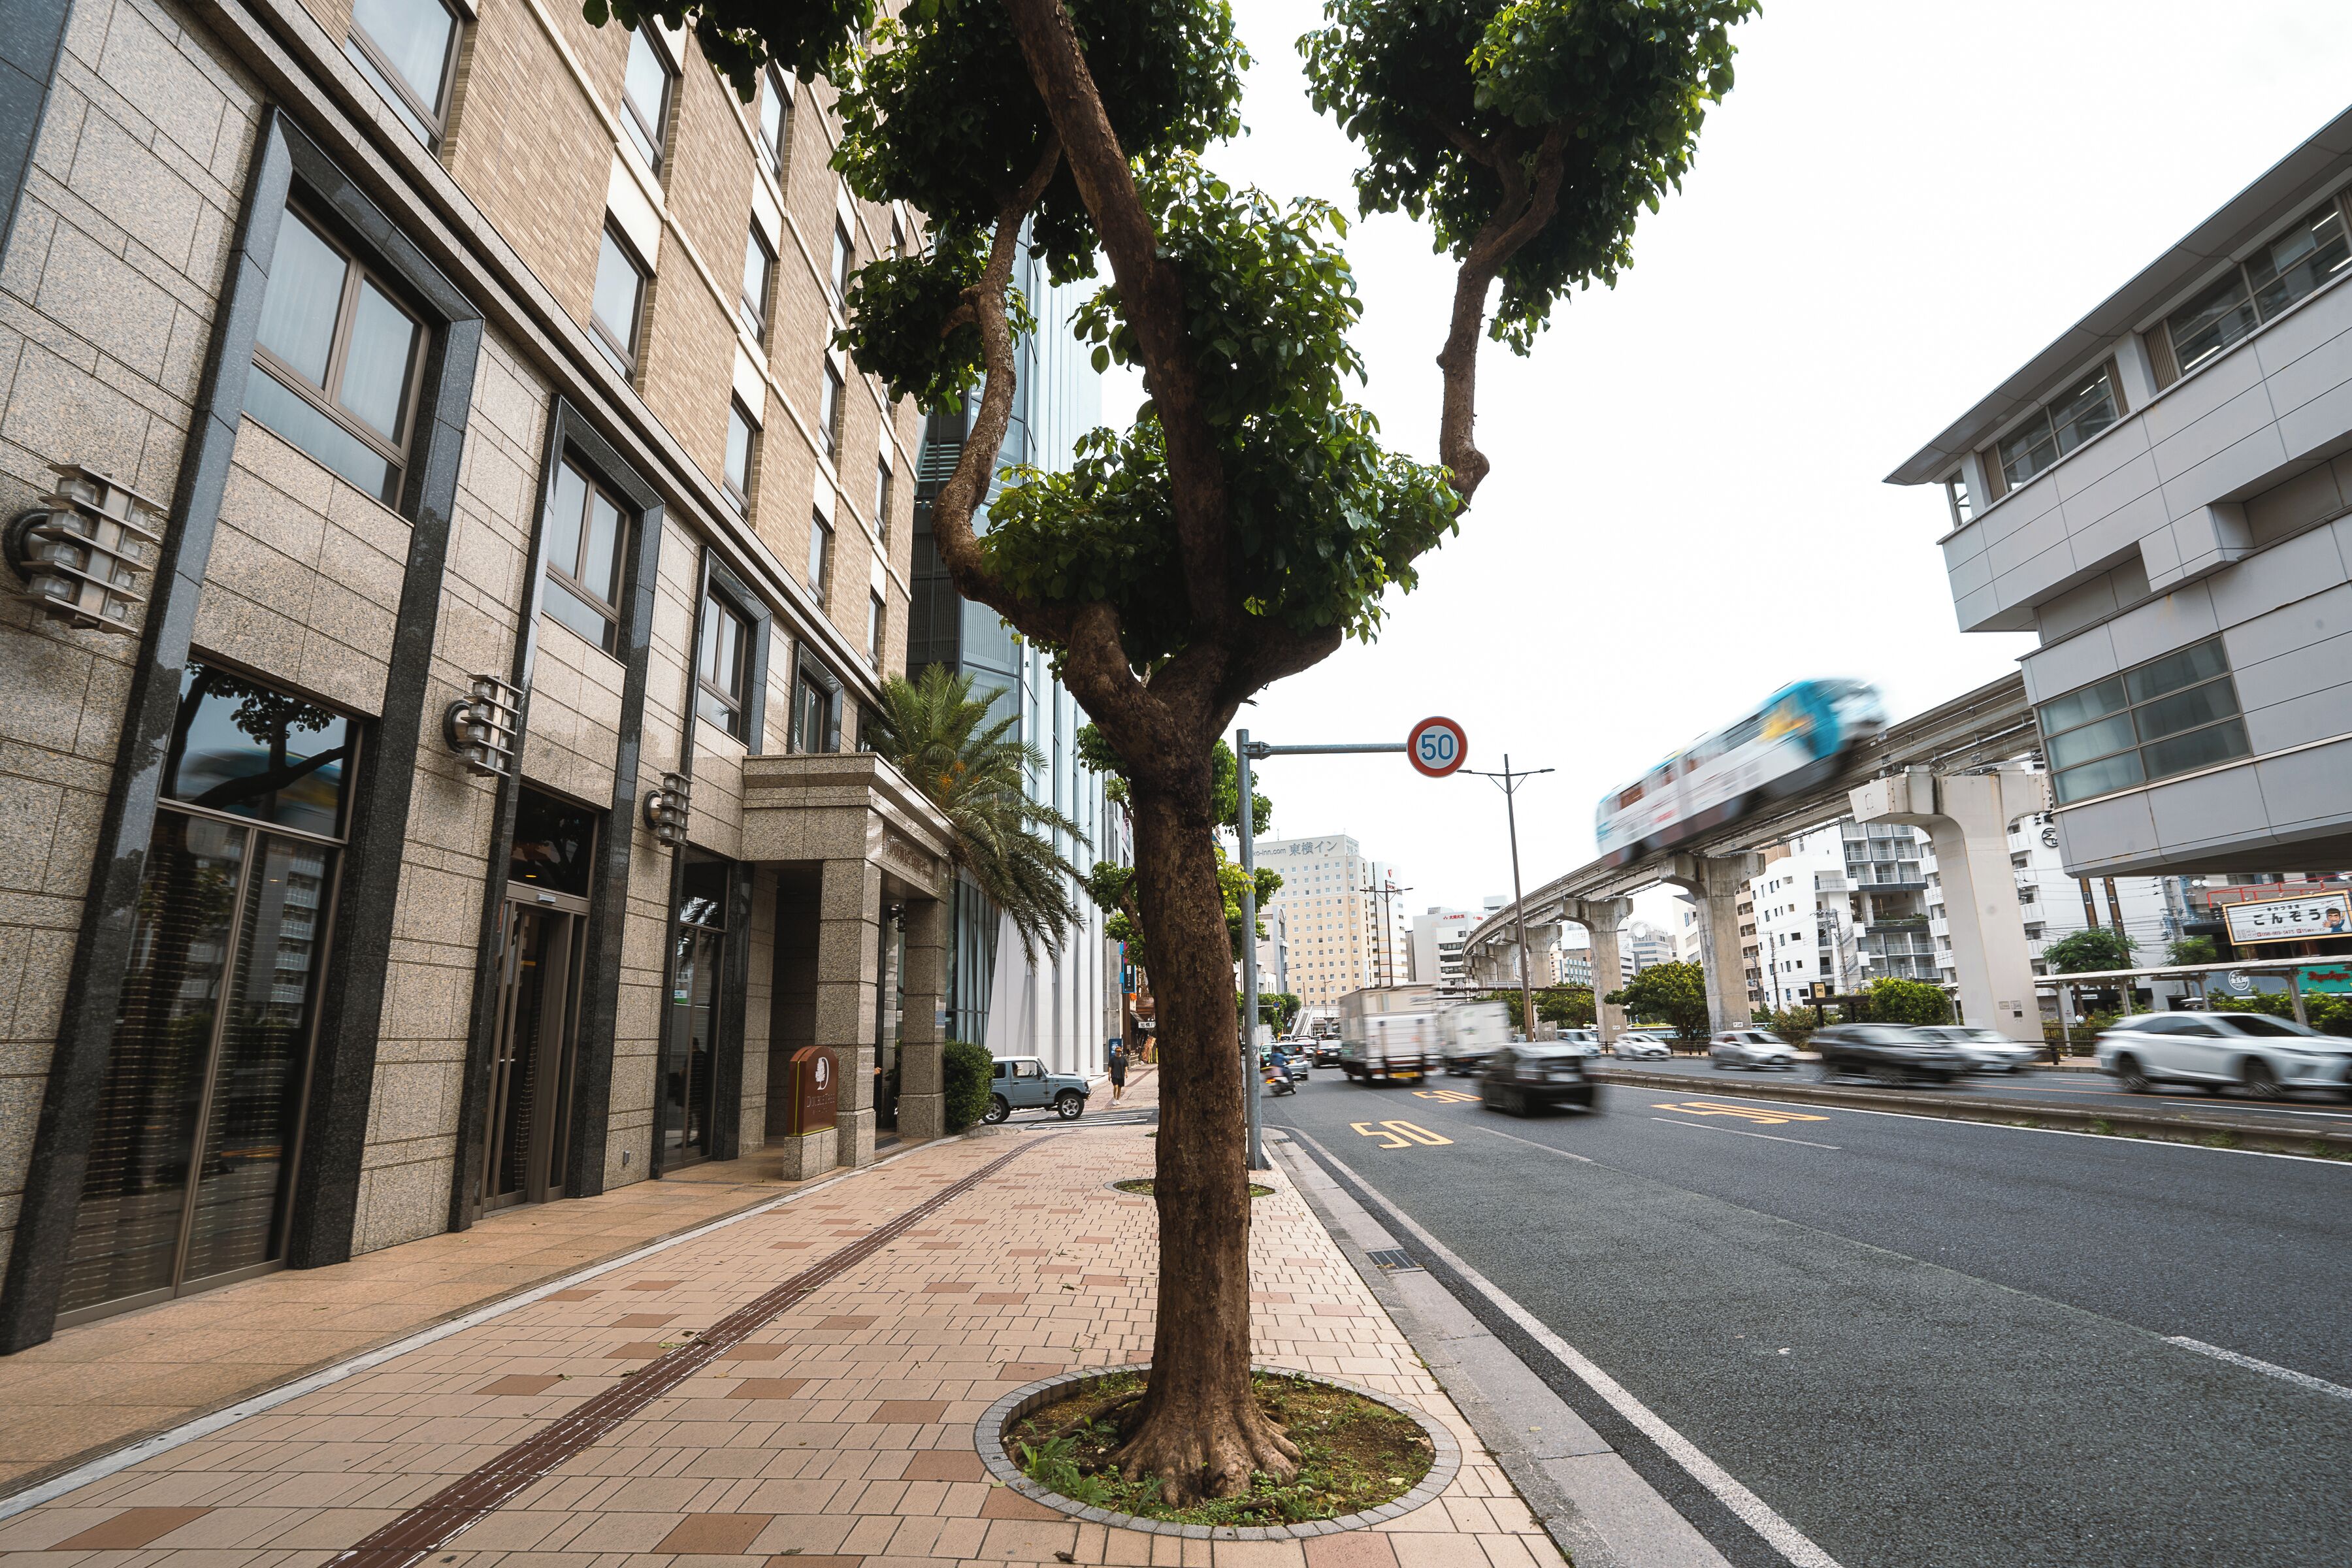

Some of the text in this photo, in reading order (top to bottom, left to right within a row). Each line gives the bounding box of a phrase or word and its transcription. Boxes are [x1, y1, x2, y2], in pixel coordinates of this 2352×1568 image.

[1421, 734, 1454, 760] 50
[1252, 848, 1286, 857] ko-inn.com
[1289, 841, 1337, 857] 東横イン
[2253, 909, 2321, 926] ごんぞう
[1411, 1090, 1484, 1103] 50
[1349, 1120, 1454, 1149] 50
